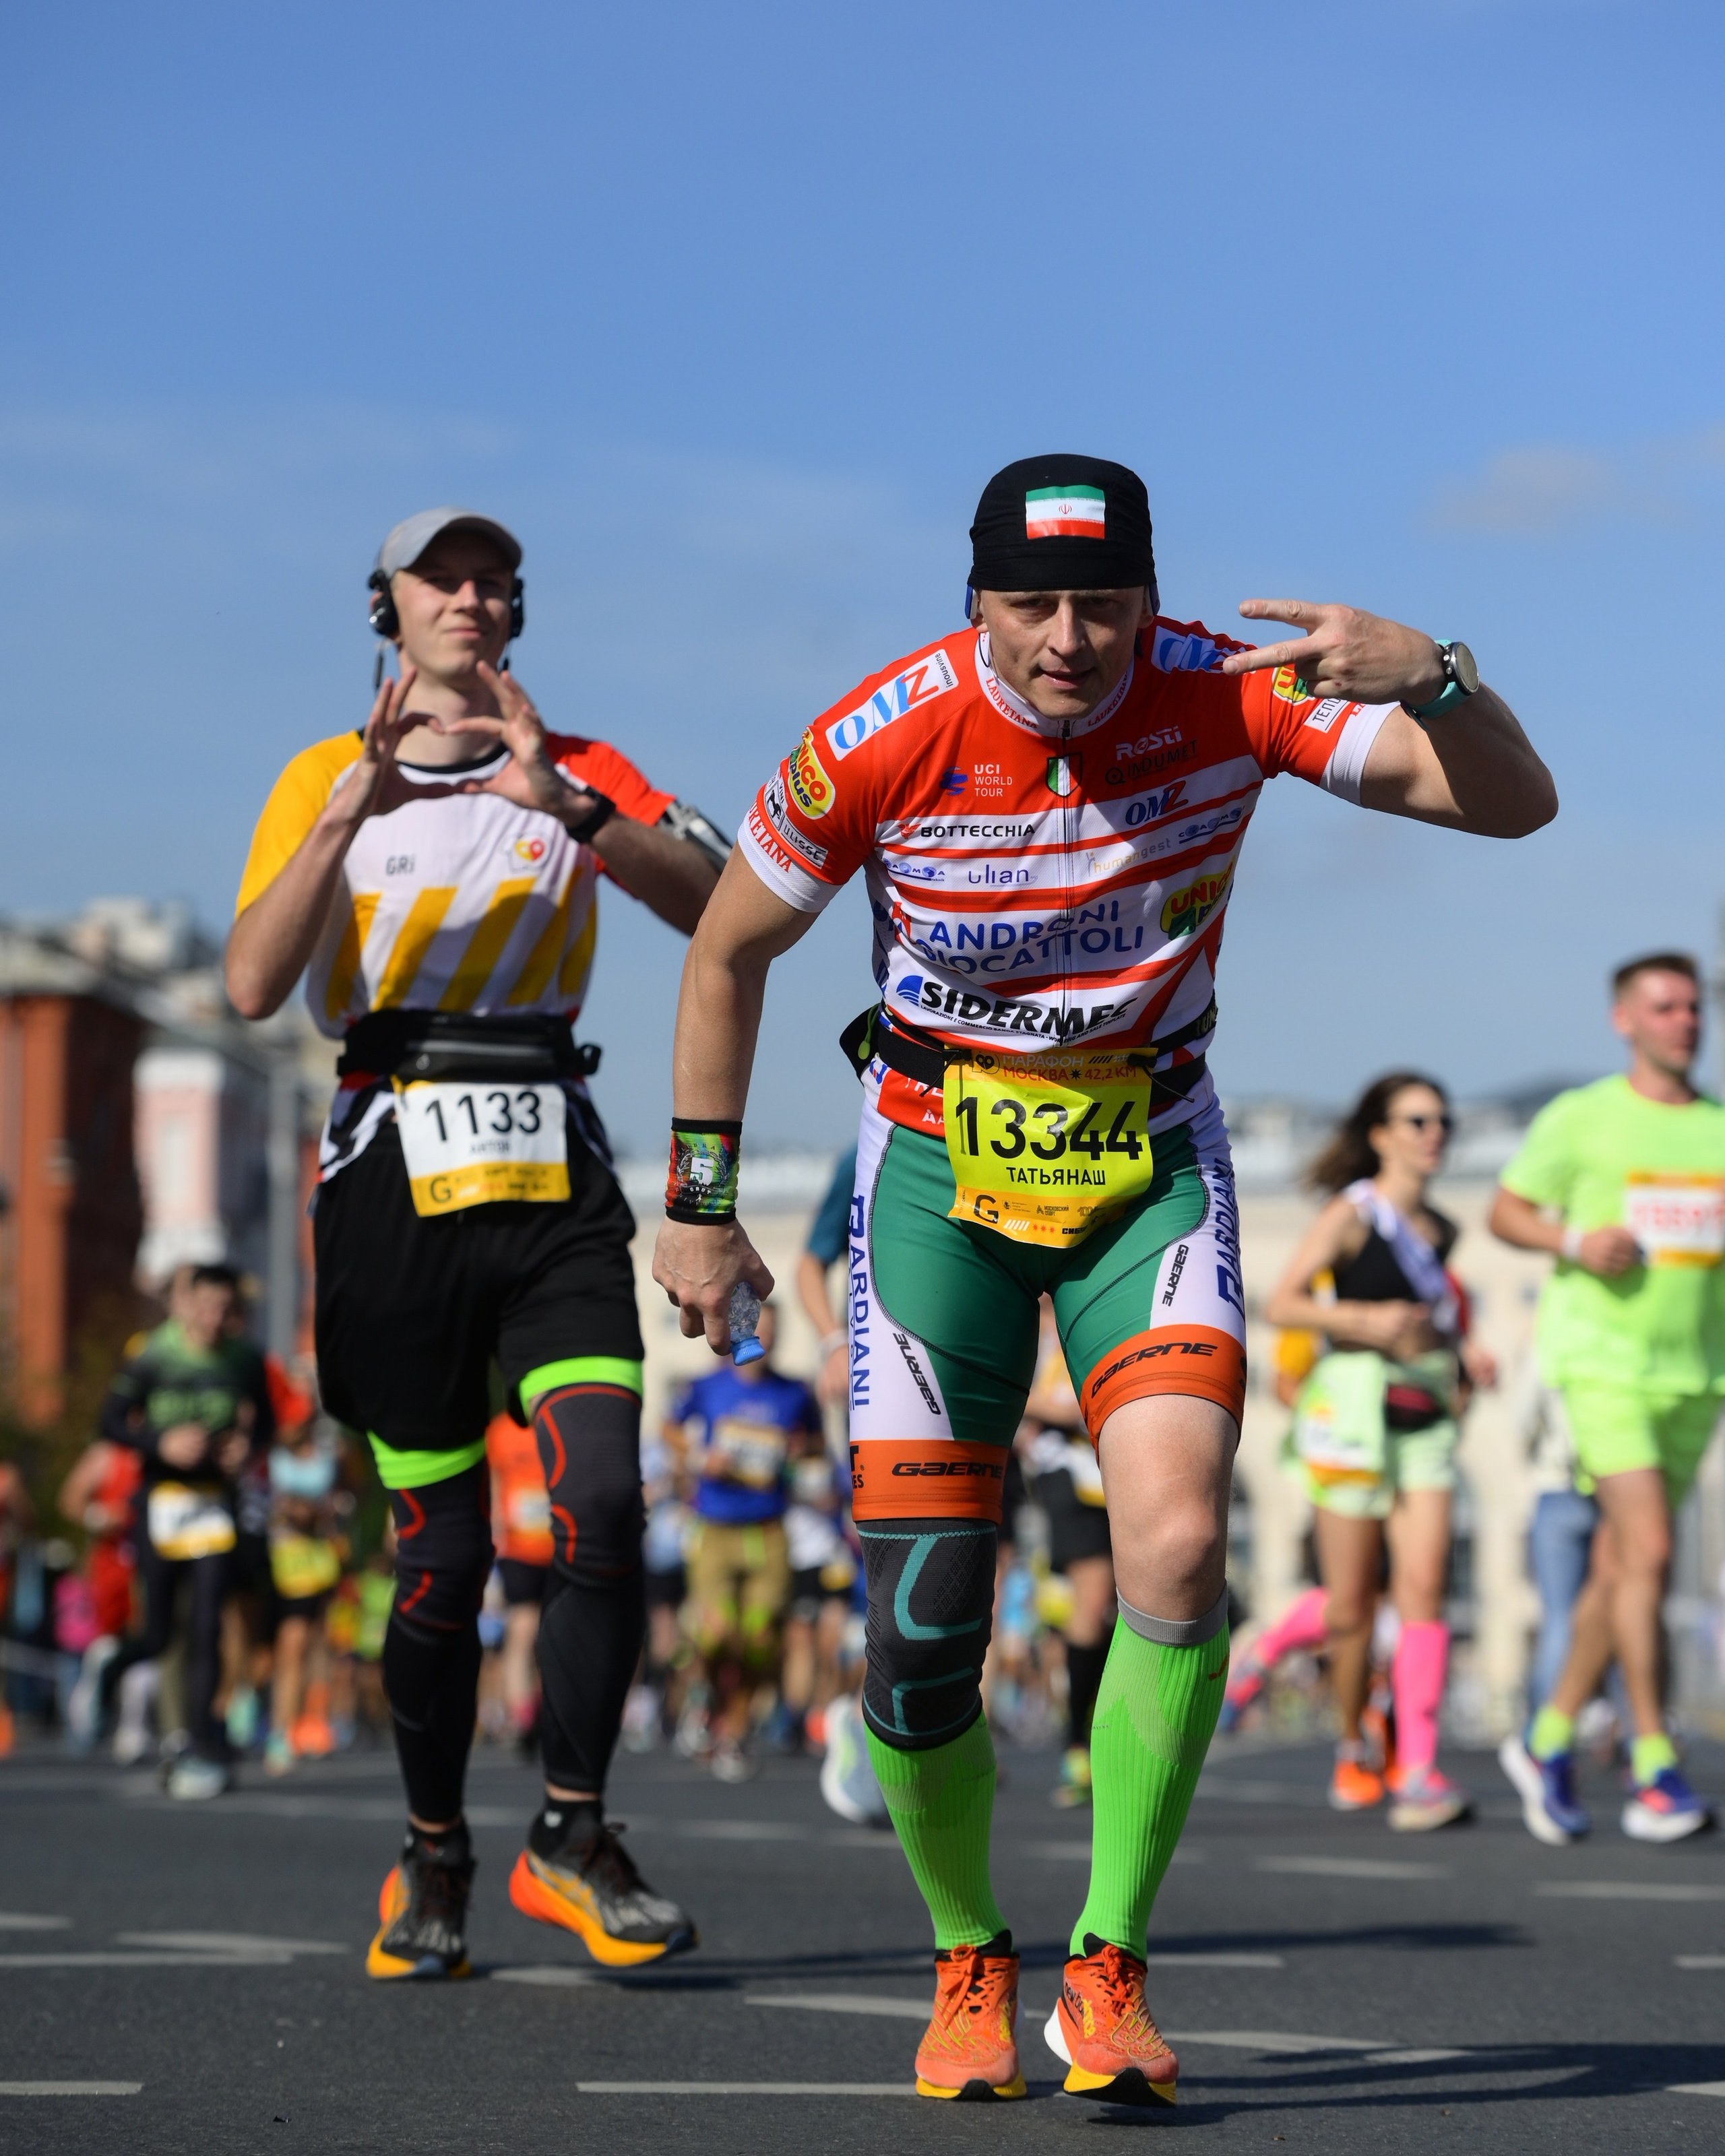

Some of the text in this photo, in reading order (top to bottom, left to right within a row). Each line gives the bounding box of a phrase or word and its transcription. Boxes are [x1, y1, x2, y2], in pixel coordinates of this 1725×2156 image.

[835, 665, 939, 749] OMZ
[790, 761, 813, 807] plus
[974, 764, 1000, 774] UCI
[974, 776, 1013, 786] WORLD
[974, 788, 1003, 797] TOUR
[1125, 780, 1189, 825] OMZ
[784, 824, 821, 860] ULISSE
[920, 824, 1036, 837] BOTTECCHIA
[1094, 838, 1172, 874] humangest
[929, 900, 1119, 950] ANDRONI
[920, 1005, 954, 1022] LAVORAZIONE
[958, 1019, 993, 1031] COMMERCIO
[1015, 1031, 1044, 1039] STAGNATA
[1076, 1030, 1090, 1039] AND
[1089, 1024, 1102, 1034] SALE
[1003, 1053, 1084, 1068] МАРАФОН
[1003, 1065, 1069, 1081] МОСКВА
[1084, 1067, 1114, 1081] 42,2
[425, 1091, 541, 1142] 1133
[955, 1096, 1143, 1161] 13344
[690, 1157, 714, 1186] 5
[1005, 1166, 1106, 1186] ТАТЬЯНАШ
[430, 1176, 452, 1203] G
[974, 1194, 999, 1224] G
